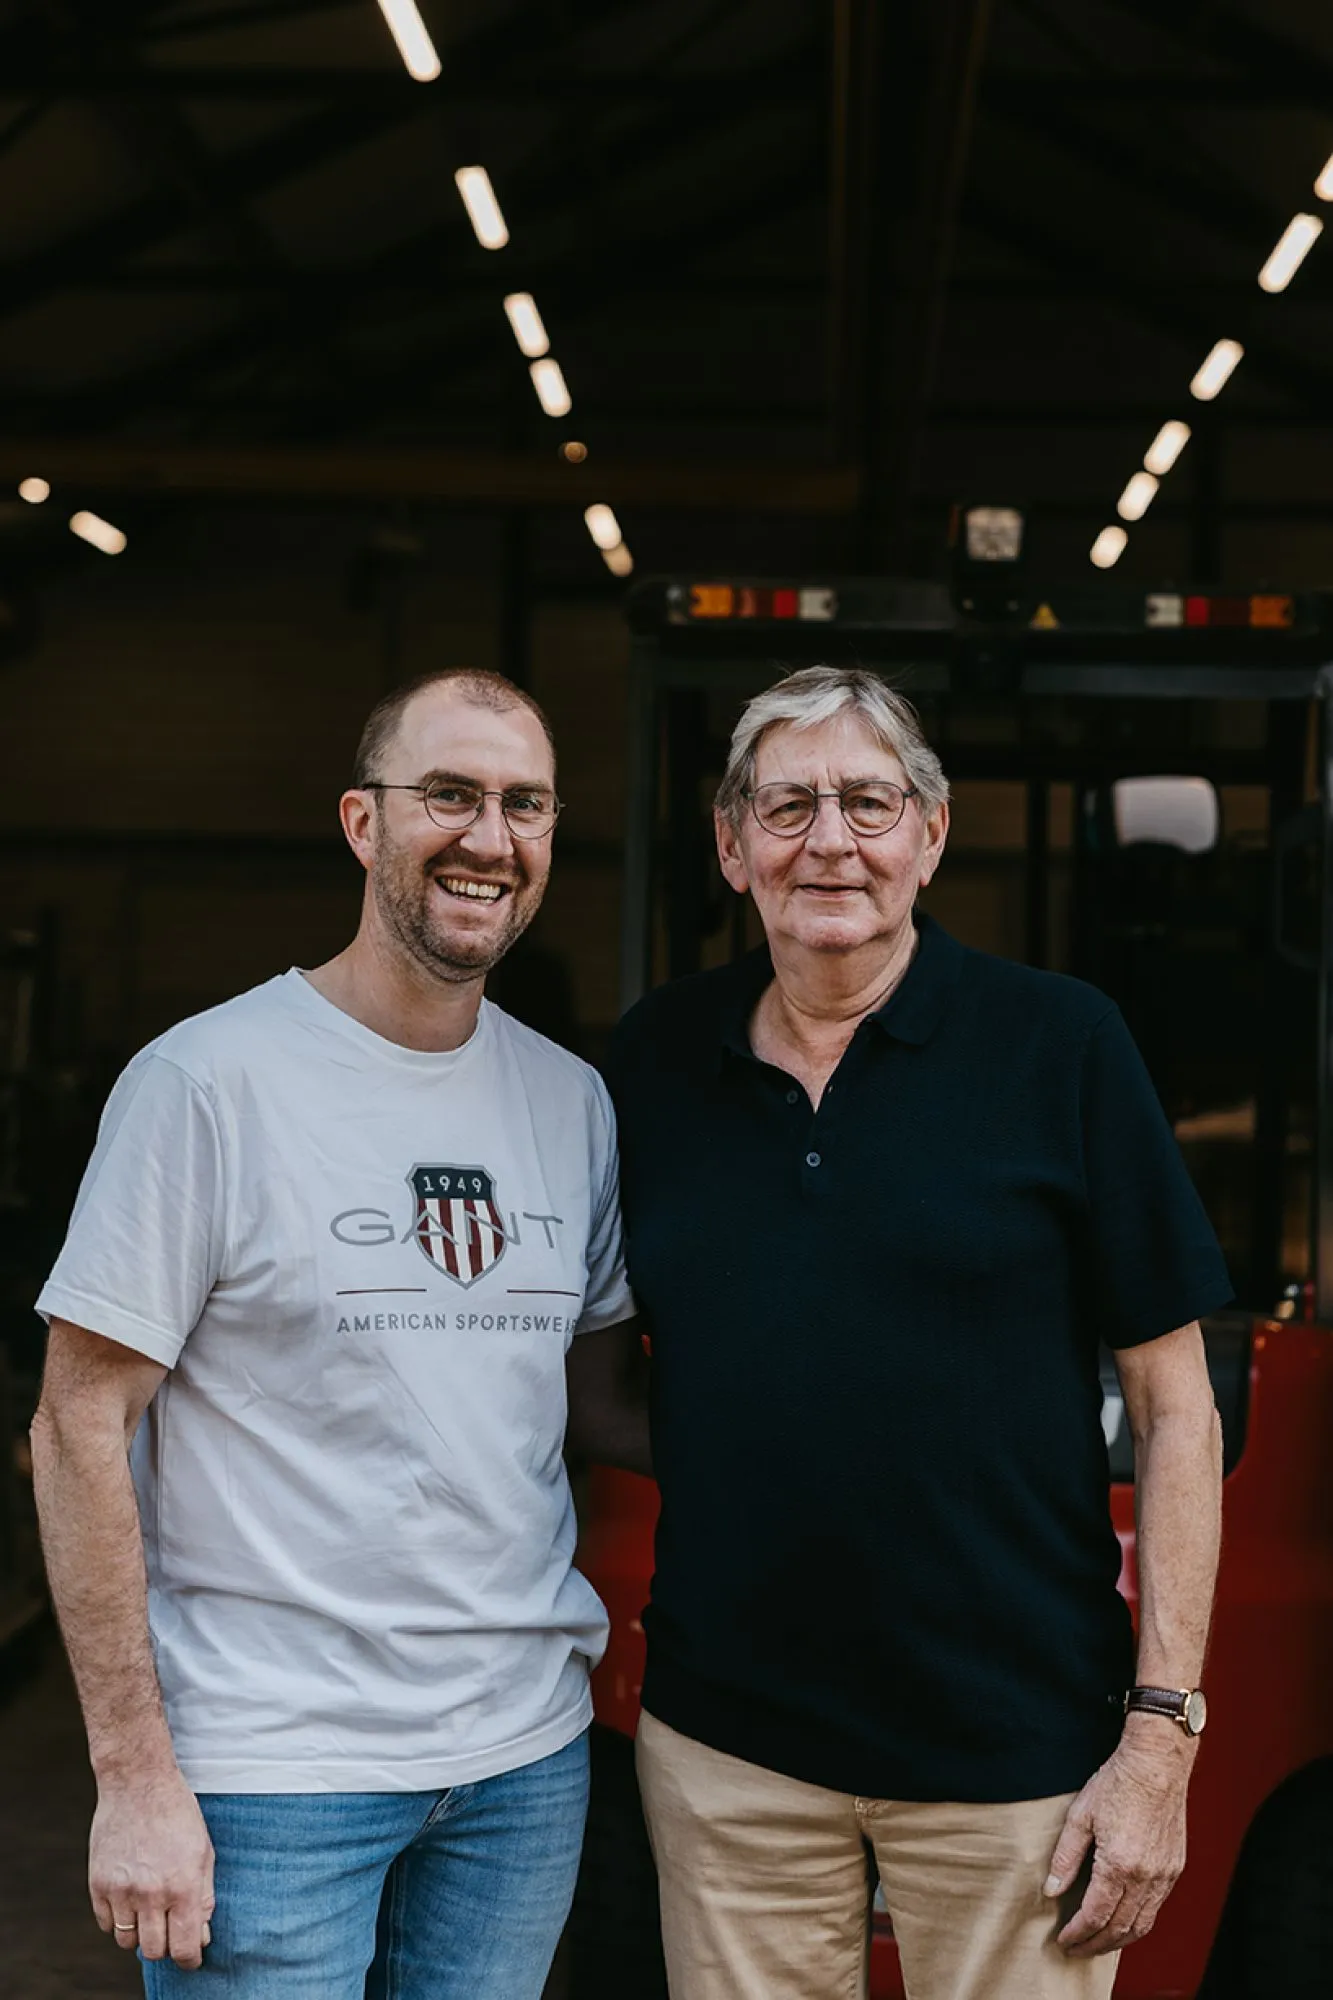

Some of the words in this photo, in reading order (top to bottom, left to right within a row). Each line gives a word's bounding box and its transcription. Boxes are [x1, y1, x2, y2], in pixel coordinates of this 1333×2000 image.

[423, 1176, 482, 1193] 1949
[331, 1208, 563, 1249] GANT
[337, 1313, 446, 1333] AMERICAN
